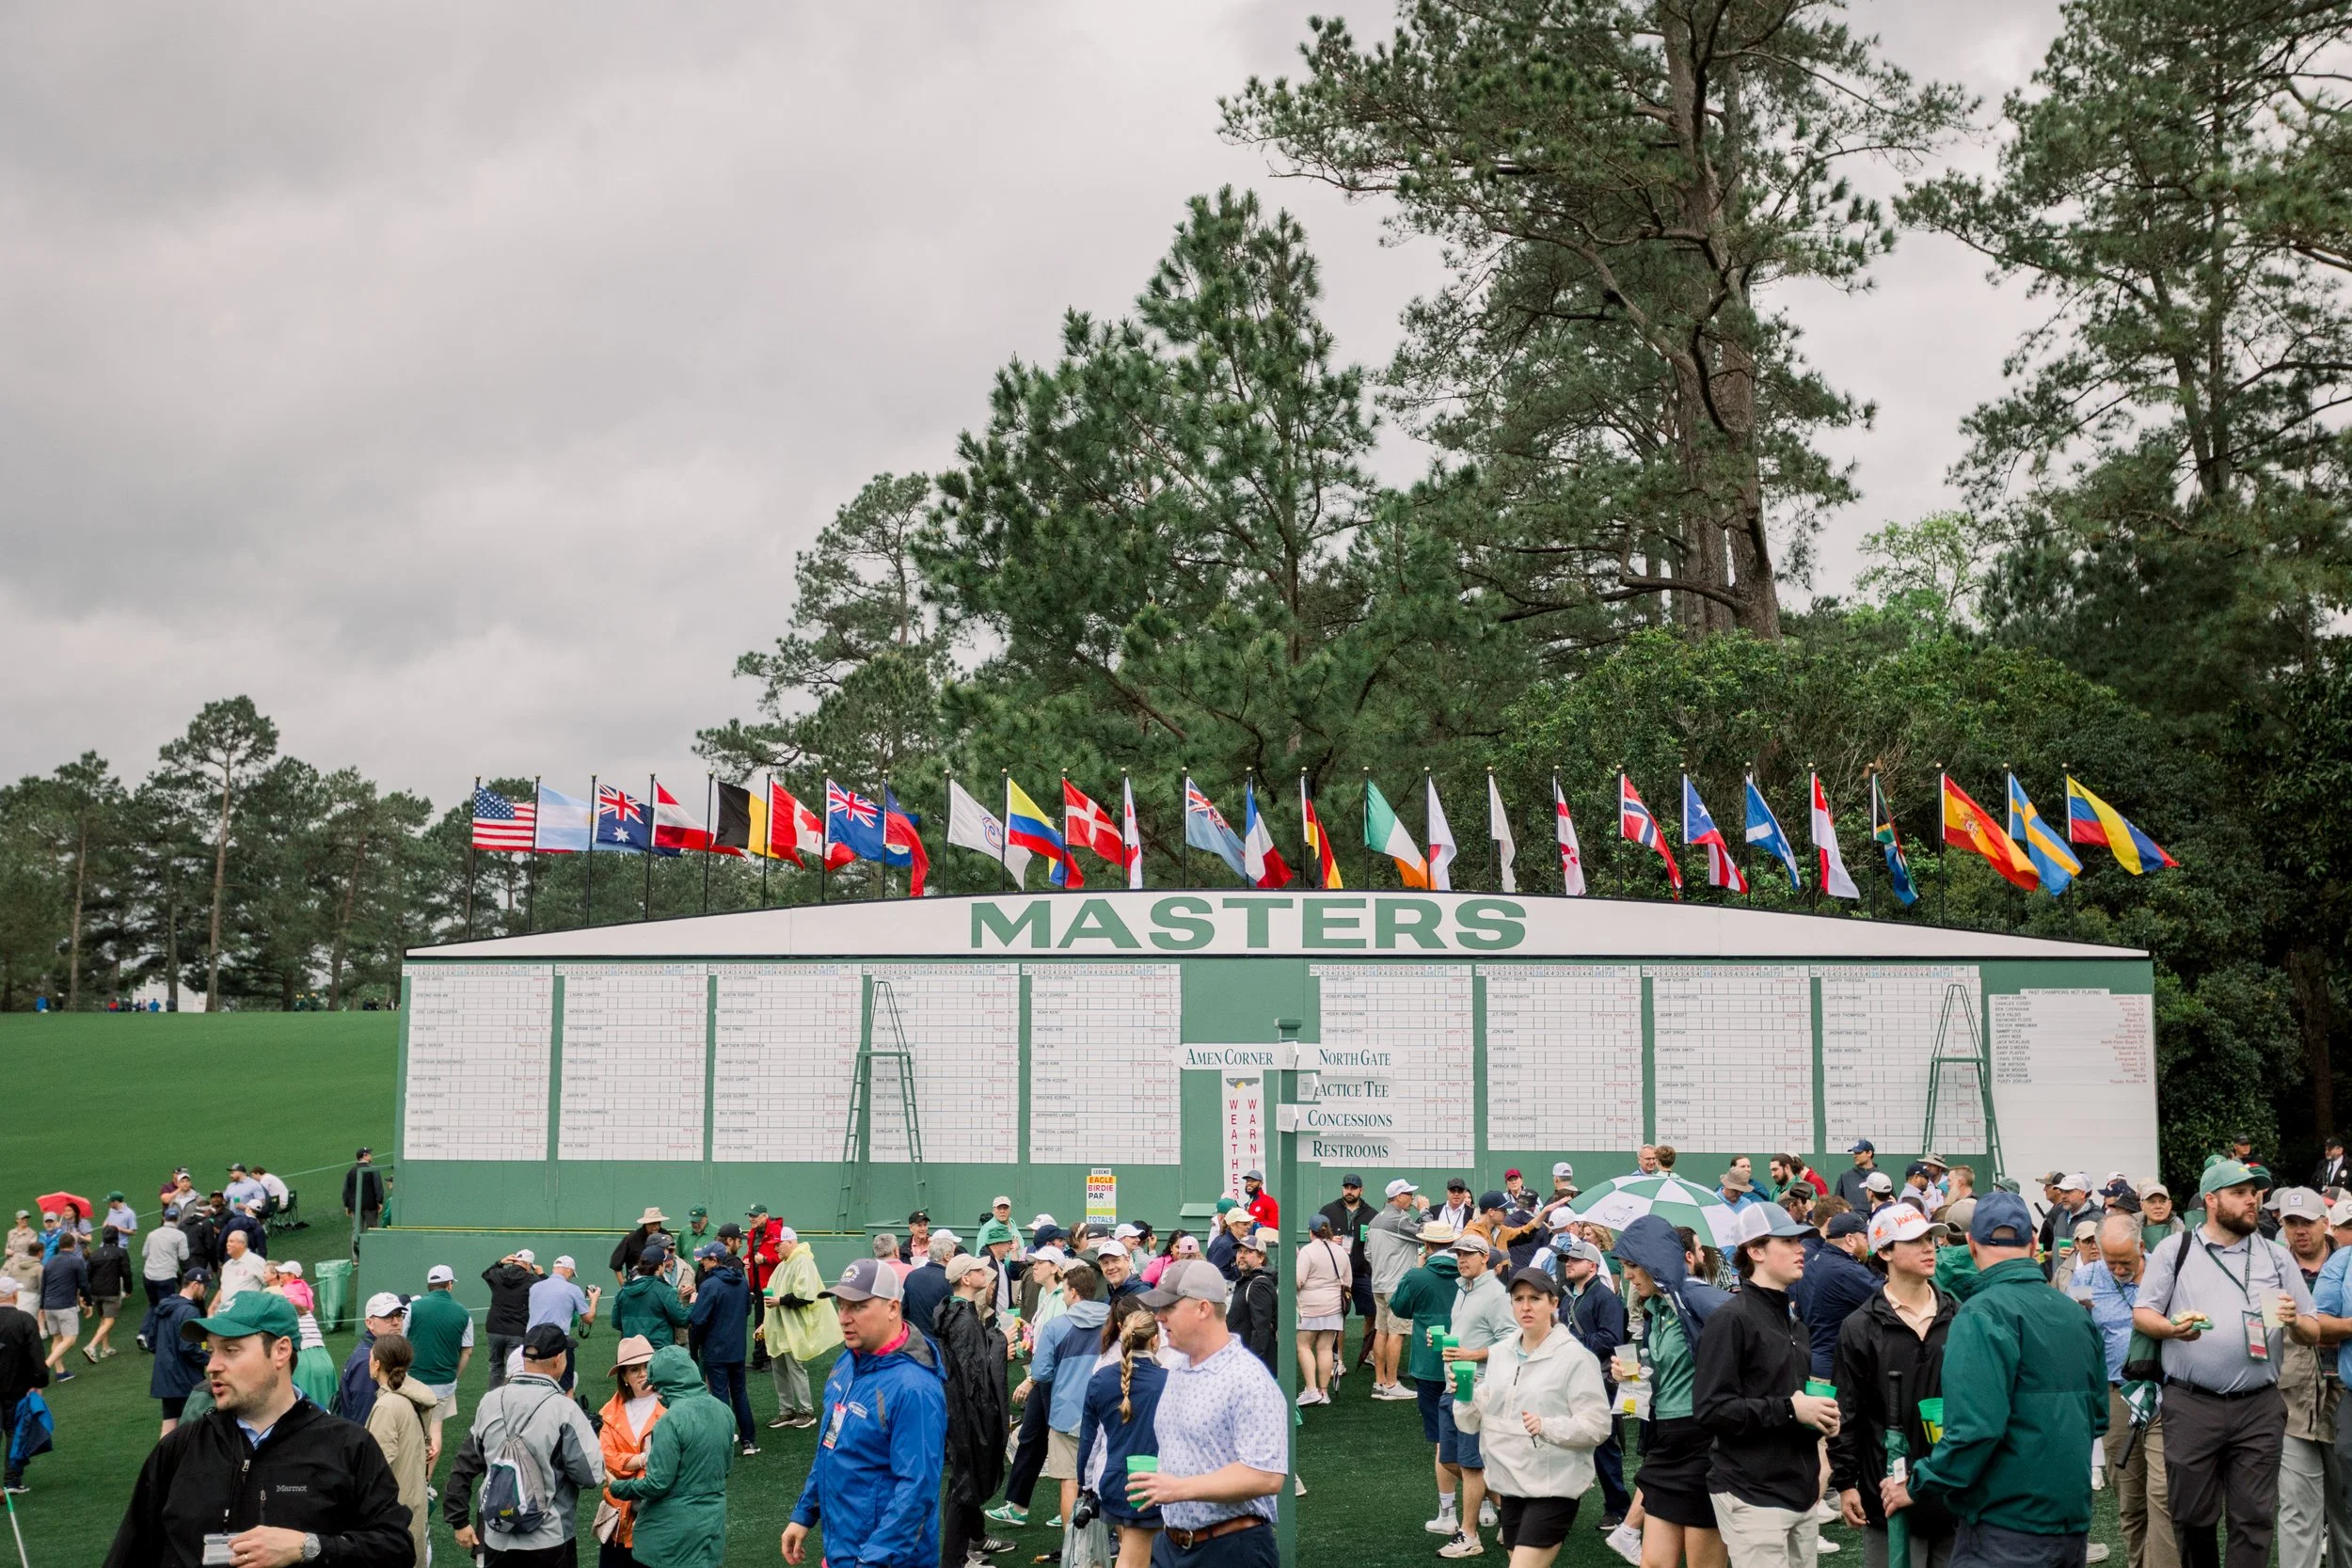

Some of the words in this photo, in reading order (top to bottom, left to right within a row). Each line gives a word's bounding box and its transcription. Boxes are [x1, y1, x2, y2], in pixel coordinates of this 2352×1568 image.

[971, 895, 1527, 950] MASTERS
[1185, 1048, 1222, 1065] AMEN
[1224, 1049, 1273, 1066] CORNER
[1319, 1048, 1359, 1066] NORTH
[1360, 1049, 1391, 1066] GATE
[1316, 1083, 1362, 1098] ACTICE
[1364, 1081, 1389, 1098] TEE
[1308, 1110, 1393, 1127] CONCESSIONS
[1248, 1099, 1257, 1169] WARNI
[1229, 1099, 1240, 1199] WEATHER
[1312, 1140, 1389, 1158] RESTROOMS
[276, 1484, 308, 1493] Marmot
